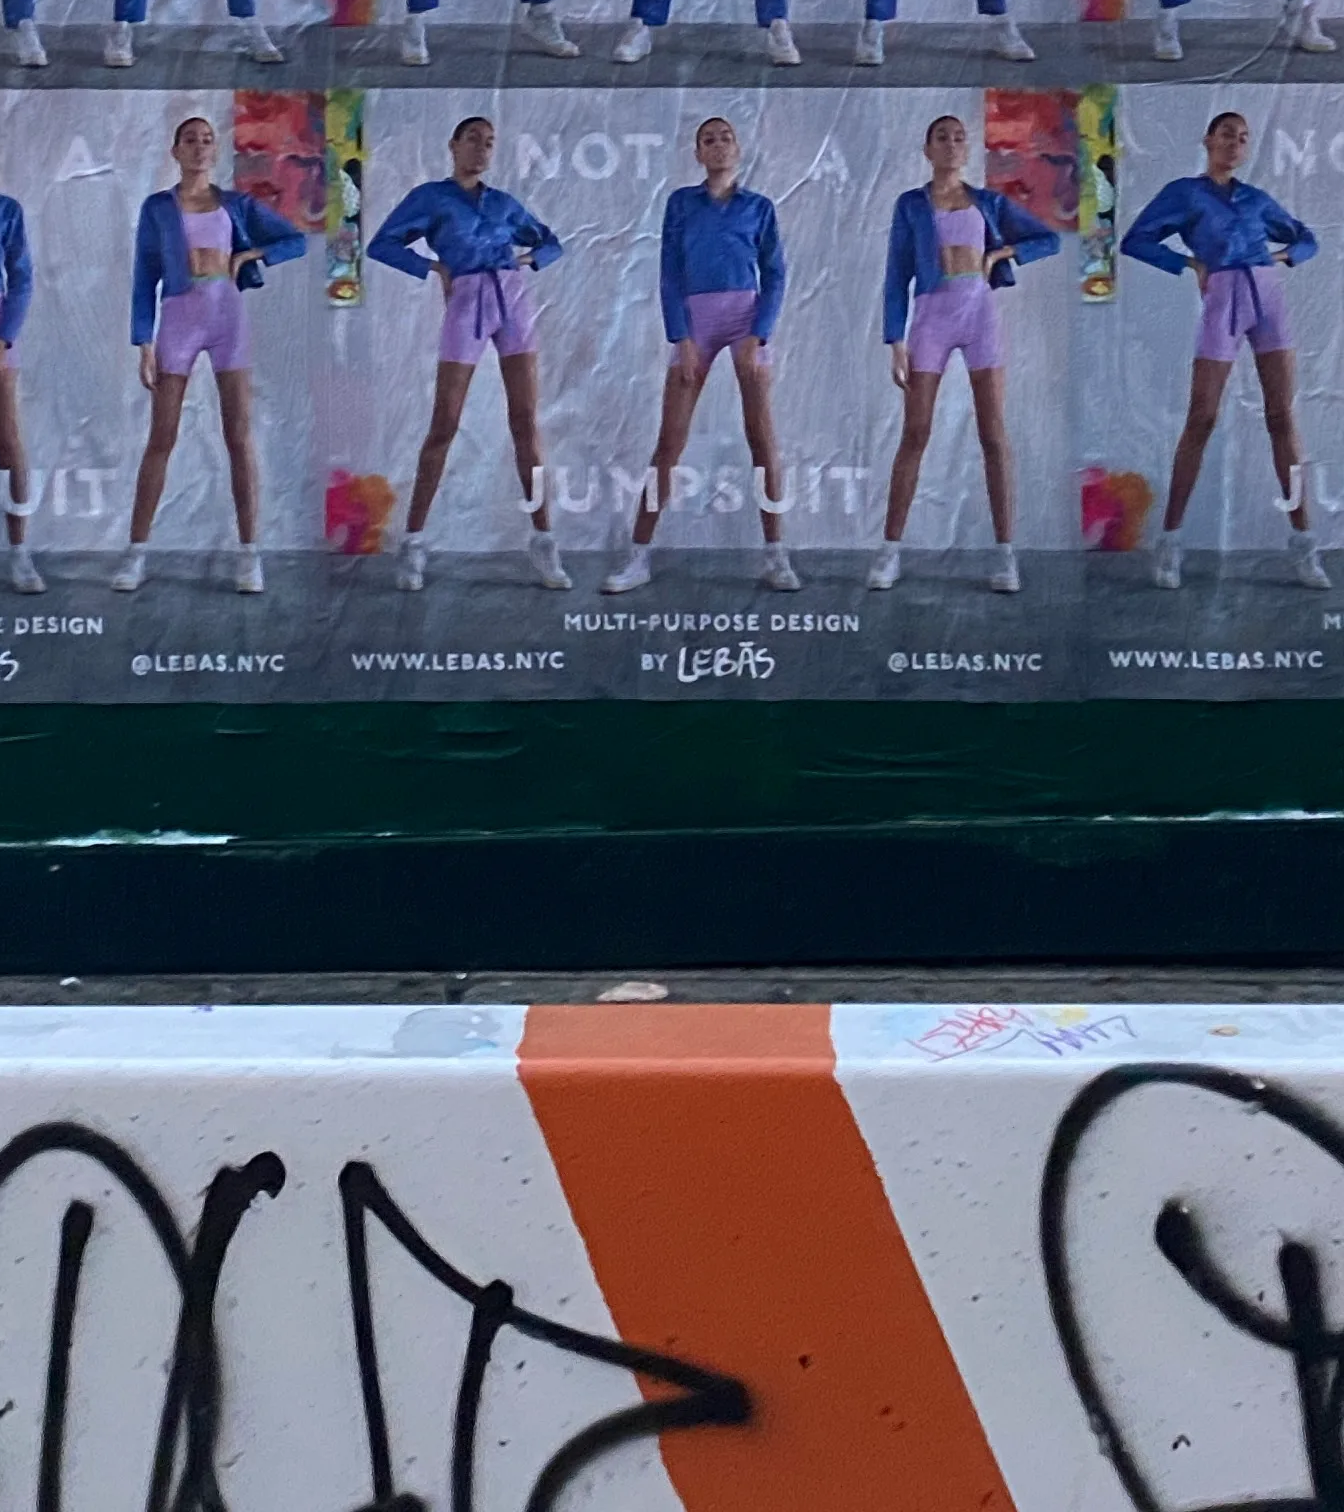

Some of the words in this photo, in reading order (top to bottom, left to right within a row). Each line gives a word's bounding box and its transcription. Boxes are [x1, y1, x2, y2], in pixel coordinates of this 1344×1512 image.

[54, 136, 97, 180] A
[517, 133, 664, 181] NOT
[811, 138, 851, 181] A
[519, 466, 872, 515] JUMPSUIT
[14, 617, 103, 635] DESIGN
[564, 614, 761, 632] MULTI-PURPOSE
[770, 613, 859, 633] DESIGN
[132, 654, 285, 674] @LEBAS.NYC
[352, 652, 565, 671] WWW.LEBAS.NYC
[641, 654, 667, 672] BY
[887, 652, 1043, 672] @LEBAS.NYC
[1109, 650, 1324, 670] WWW.LEBAS.NYC
